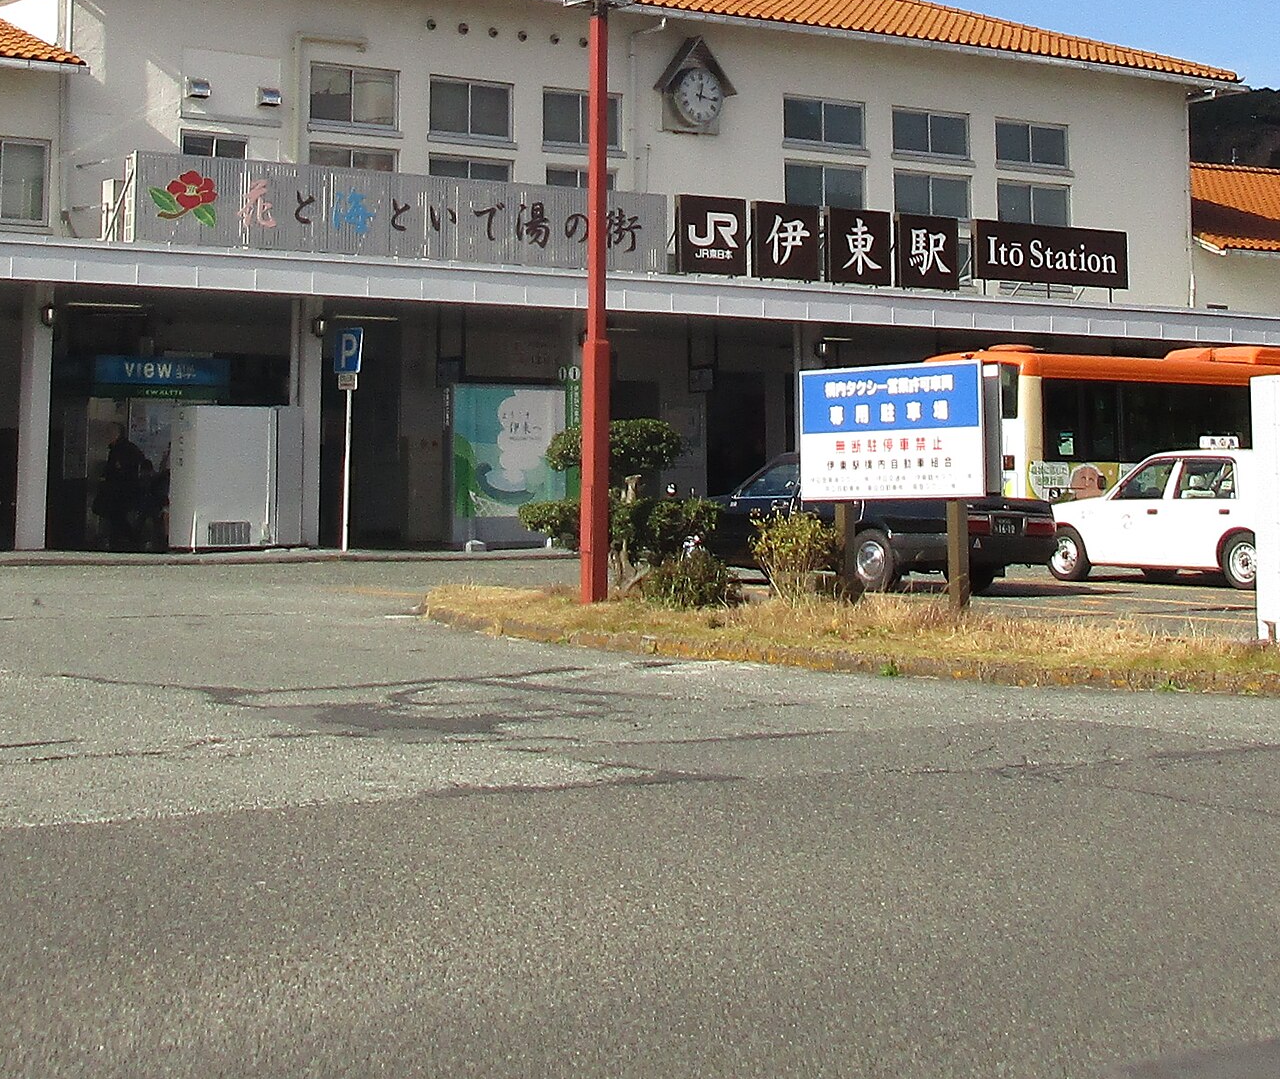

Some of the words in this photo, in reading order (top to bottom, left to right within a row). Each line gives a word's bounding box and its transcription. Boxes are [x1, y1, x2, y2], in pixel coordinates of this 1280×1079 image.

[688, 212, 739, 248] JR
[765, 214, 952, 277] 伊東駅
[695, 248, 733, 259] JR東日本
[1029, 238, 1118, 275] Station
[341, 333, 358, 369] P
[835, 437, 943, 454] 無断駐停車禁止
